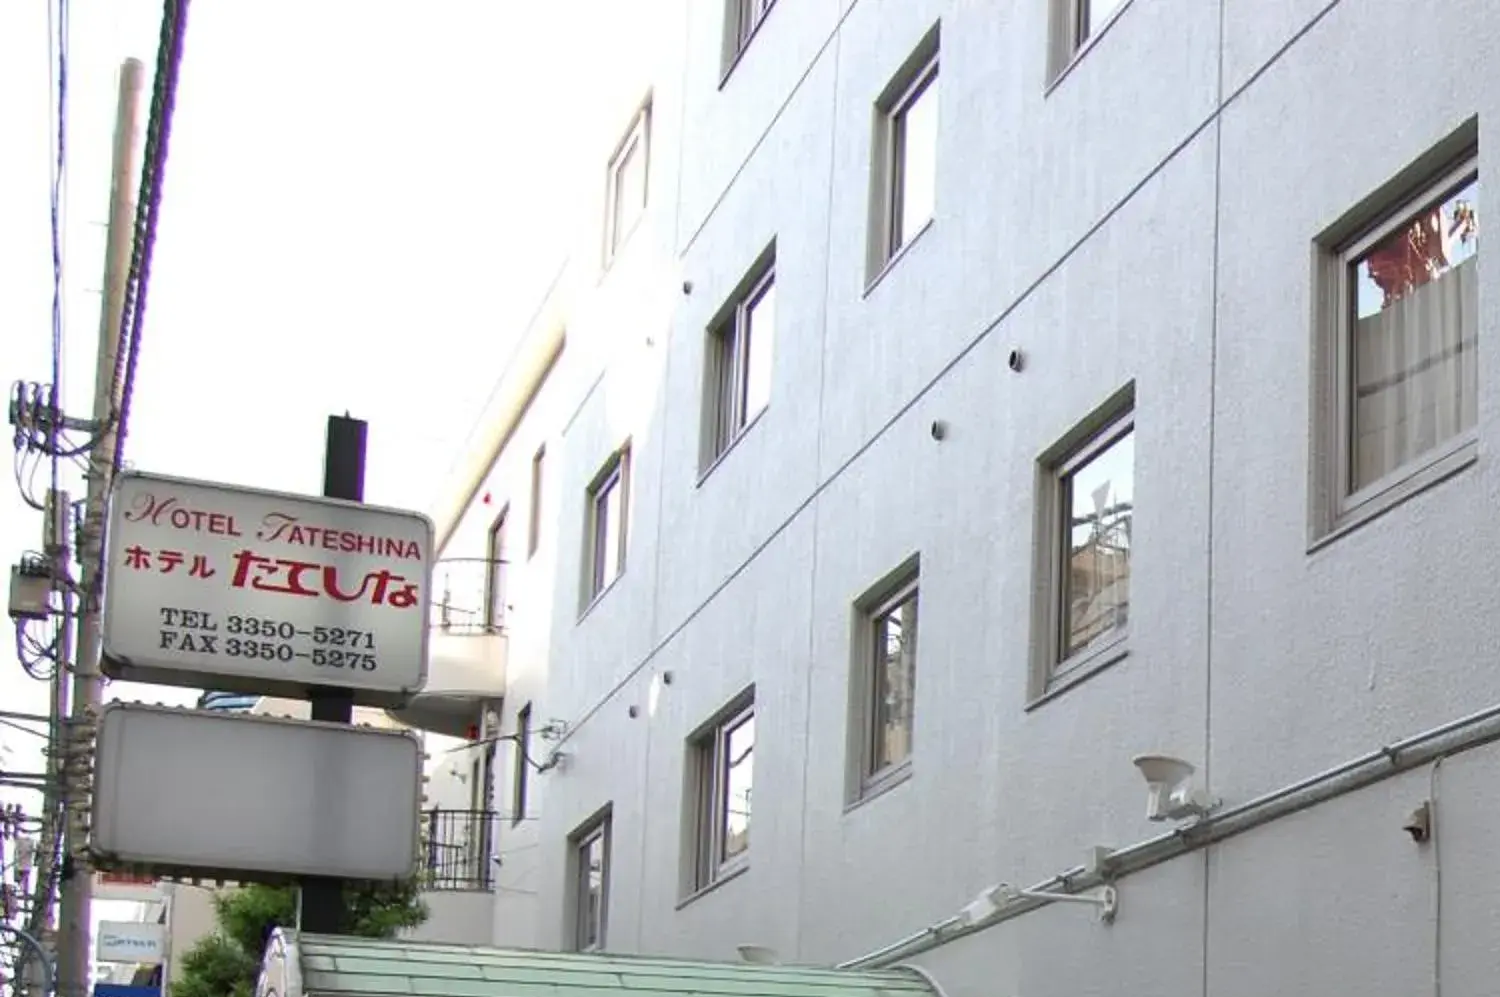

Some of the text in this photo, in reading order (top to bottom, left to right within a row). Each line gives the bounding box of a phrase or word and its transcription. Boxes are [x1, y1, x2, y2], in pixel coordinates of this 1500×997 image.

[124, 495, 421, 560] HOTEL TATESHINA
[125, 545, 418, 608] ホテル たてしな
[159, 630, 377, 671] FAX 3350-5275
[160, 607, 376, 649] TEL 3350-5271
